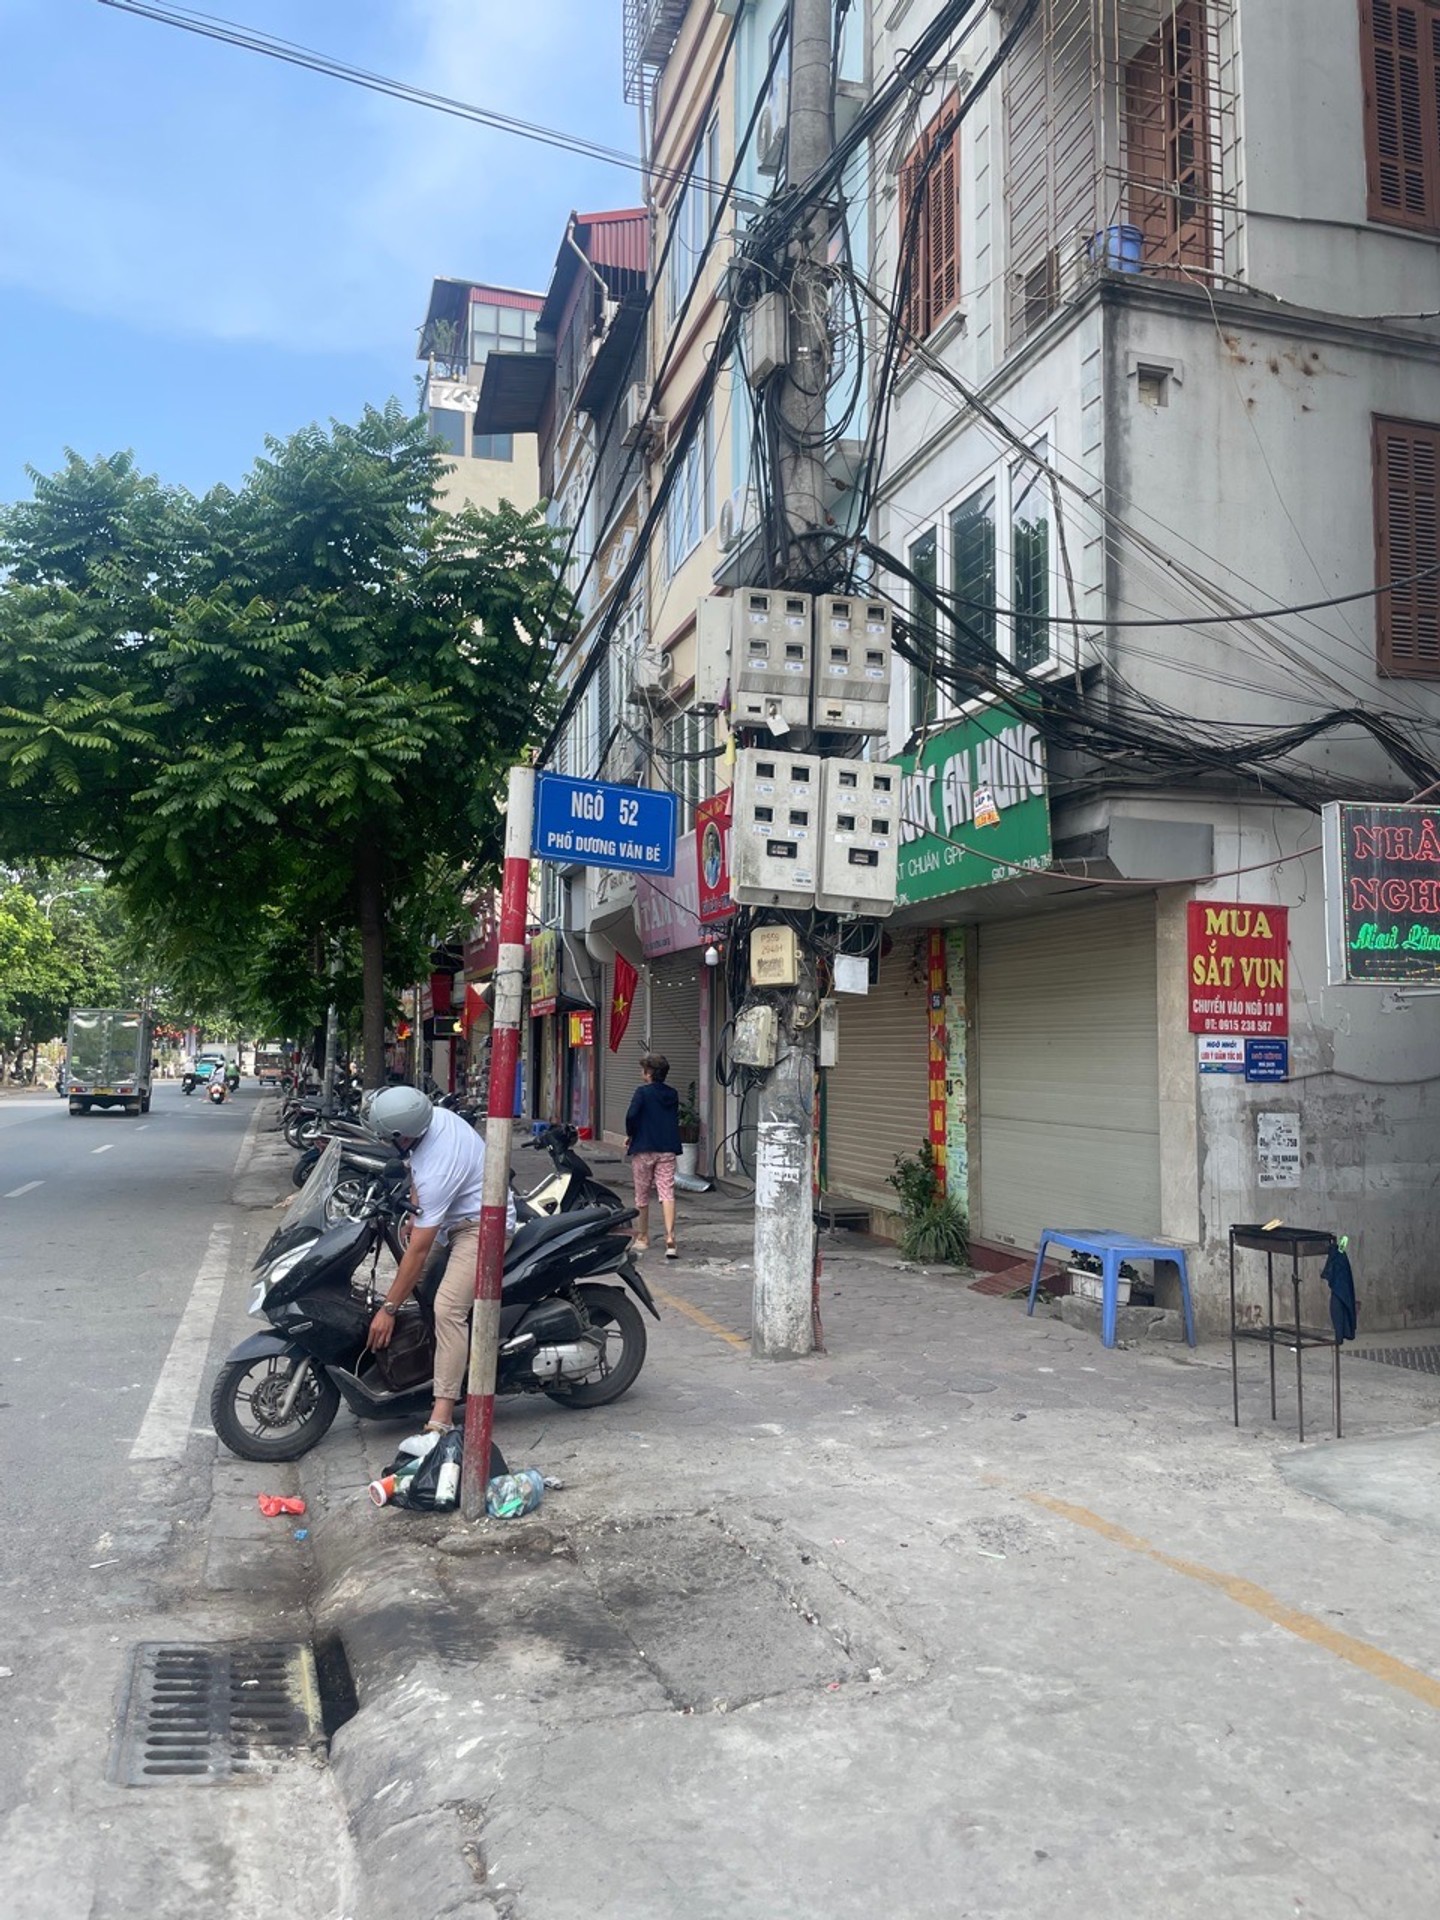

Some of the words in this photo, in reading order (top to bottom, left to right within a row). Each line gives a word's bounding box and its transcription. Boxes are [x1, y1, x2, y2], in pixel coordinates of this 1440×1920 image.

[571, 789, 605, 822] NGÕ
[619, 798, 639, 827] 52
[942, 749, 972, 837] AN
[547, 829, 574, 850] PHỐ
[575, 836, 616, 856] DƯƠNG
[619, 840, 643, 860] VĂN
[646, 843, 661, 862] BÉ
[1353, 819, 1440, 861] NHÀ
[1351, 877, 1440, 914] NGH
[1205, 908, 1273, 938] MUA
[1192, 938, 1235, 986] SẮT
[1239, 956, 1284, 997] VỤN
[1227, 998, 1243, 1015] VÀO
